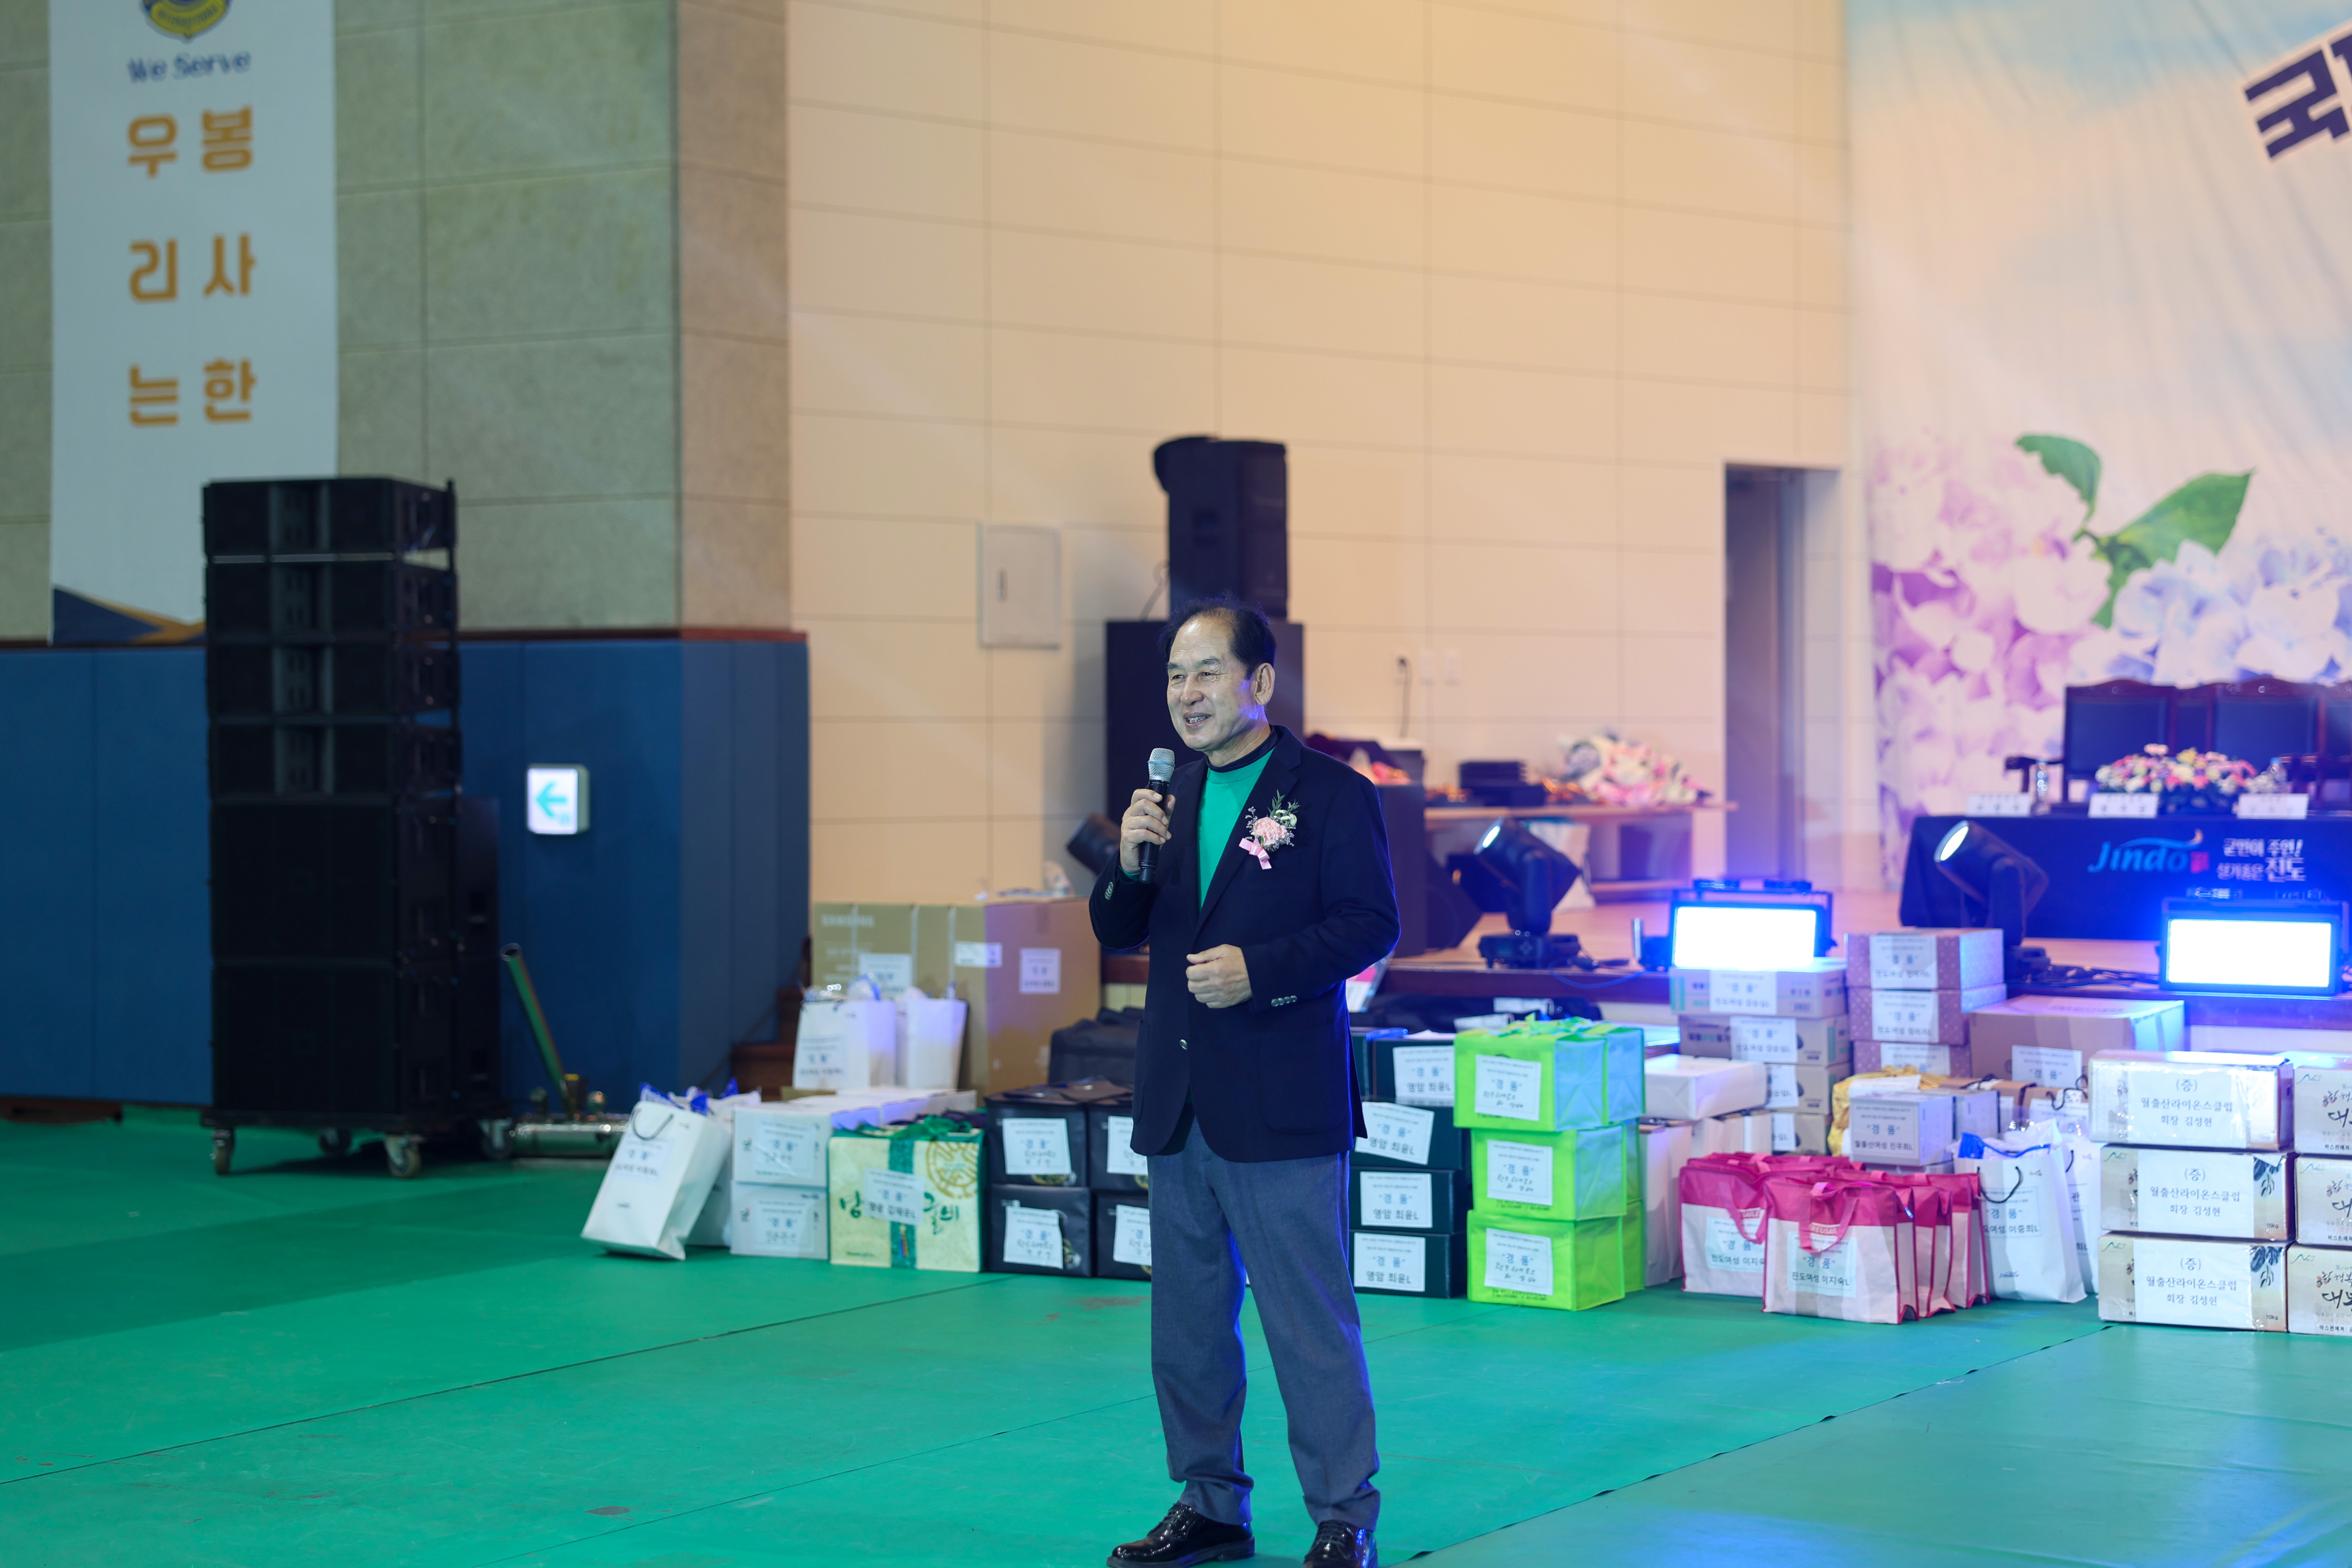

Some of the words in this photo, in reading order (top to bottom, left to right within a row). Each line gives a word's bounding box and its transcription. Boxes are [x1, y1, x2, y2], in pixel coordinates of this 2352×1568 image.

[127, 57, 168, 83] We
[172, 51, 252, 80] Serve
[2245, 33, 2352, 158] 국
[2223, 838, 2265, 857] 군민이
[2087, 841, 2189, 873] Jindo
[2264, 857, 2307, 882] 진도
[2141, 1097, 2233, 1112] 월출산라이온스클럽
[2161, 1114, 2178, 1126] 회장
[2185, 1116, 2213, 1127] 김성현
[2184, 1167, 2206, 1181] (증)
[2150, 1186, 2241, 1202] 월출산라이온스클럽
[2170, 1205, 2187, 1215] 회장
[2194, 1205, 2221, 1217] 김성현
[2180, 1257, 2201, 1270] (증)
[1792, 1271, 1819, 1283] 진도여성
[1822, 1275, 1849, 1286] 이지숙L
[2146, 1275, 2238, 1290] 월출산라이온스클럽
[2166, 1294, 2185, 1304] 회장
[2190, 1295, 2218, 1306] 김성현
